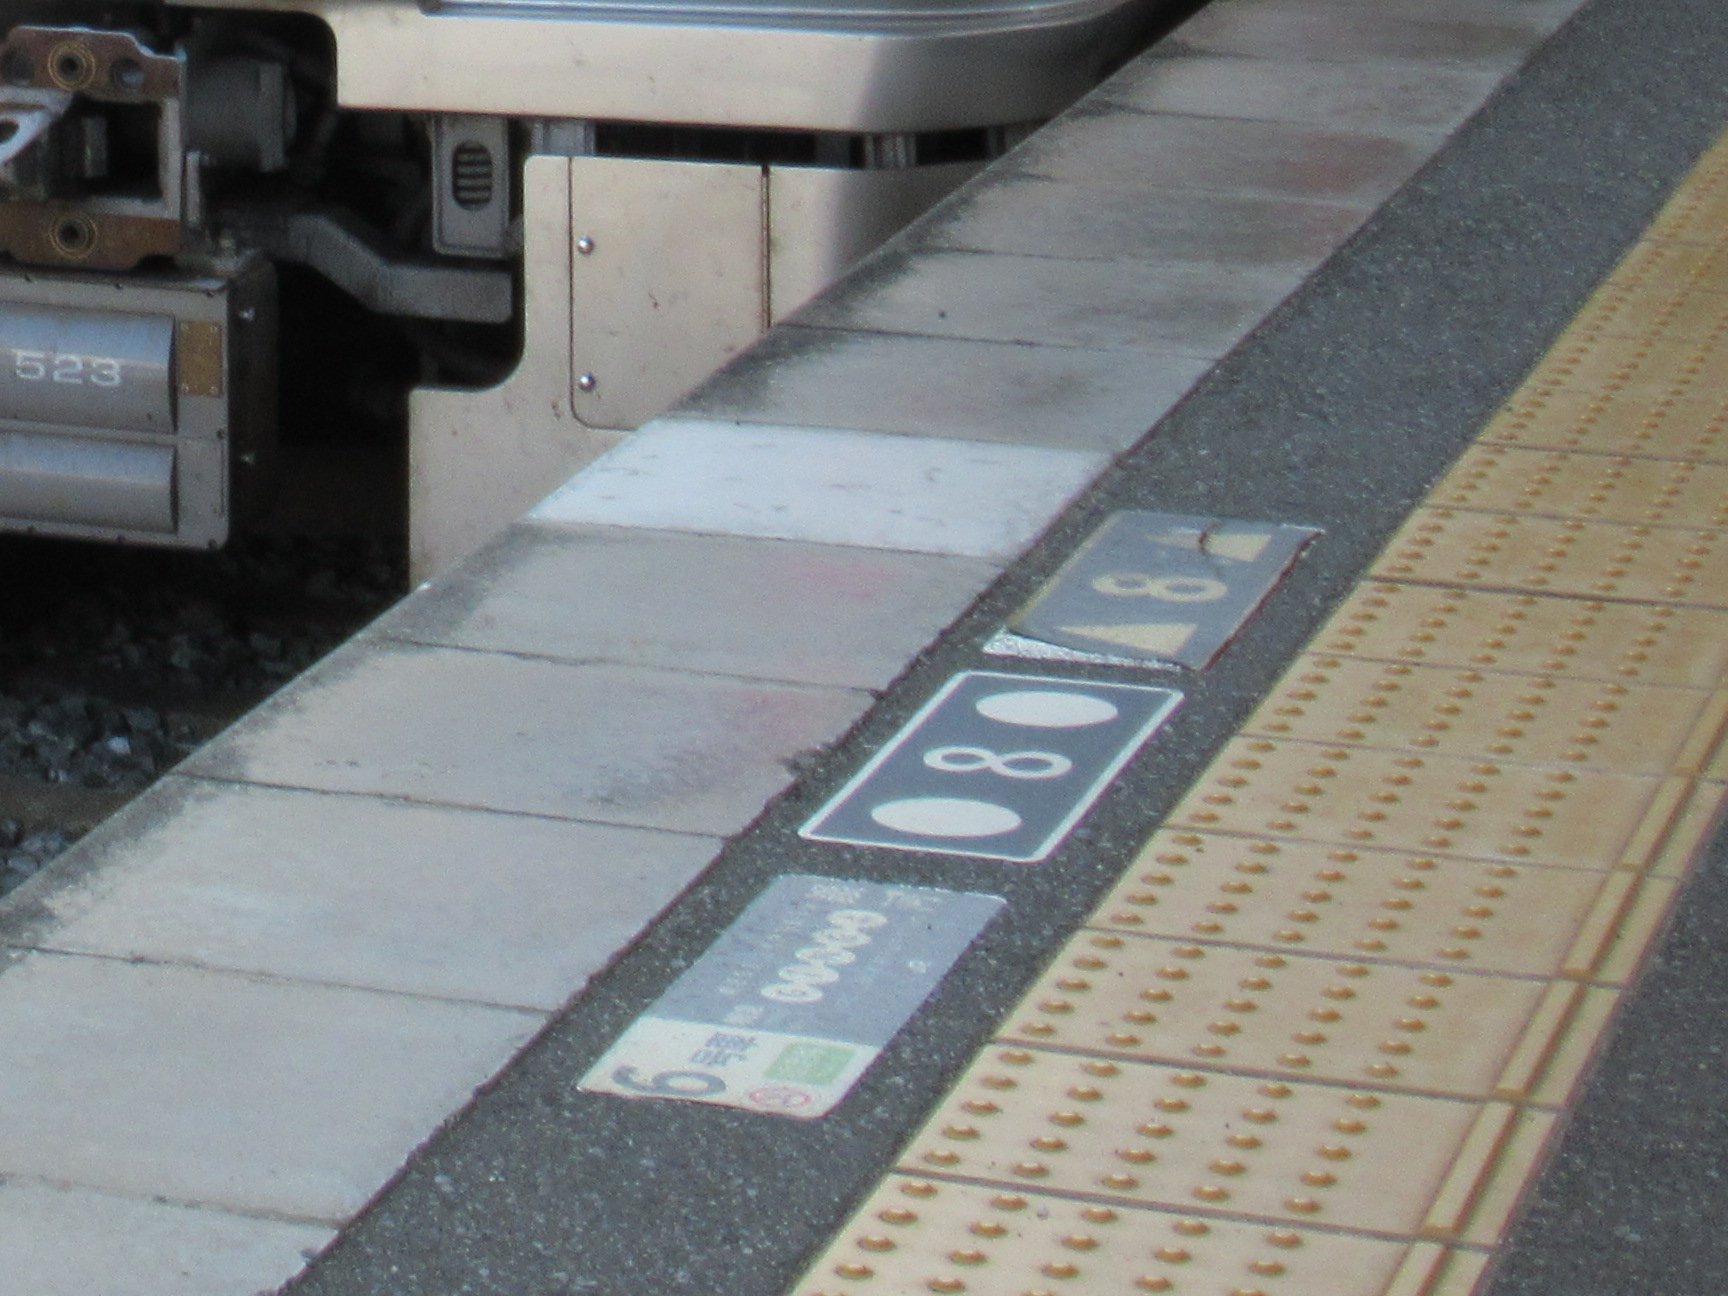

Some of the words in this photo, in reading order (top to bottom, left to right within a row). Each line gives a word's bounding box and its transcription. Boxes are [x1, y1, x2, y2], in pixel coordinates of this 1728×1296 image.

[14, 348, 122, 388] 523
[1092, 571, 1229, 603] 8
[922, 745, 1074, 780] 8
[611, 1064, 727, 1097] 6
